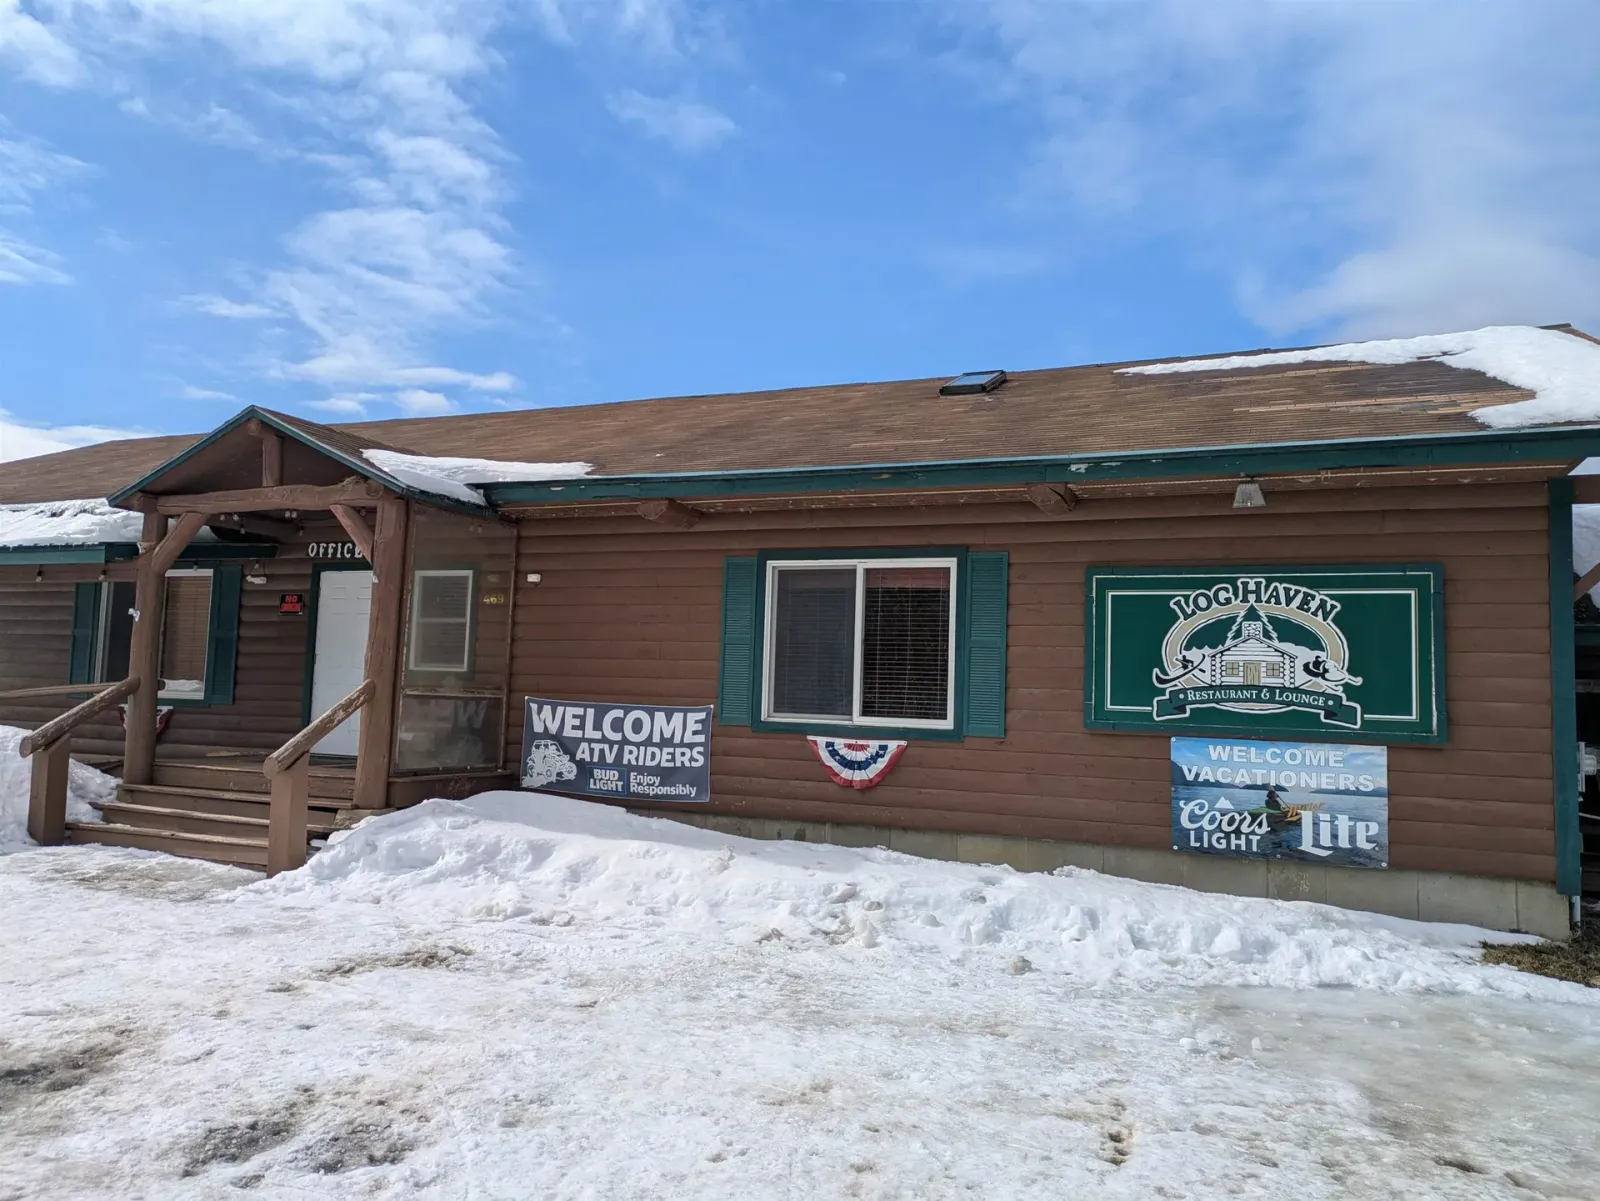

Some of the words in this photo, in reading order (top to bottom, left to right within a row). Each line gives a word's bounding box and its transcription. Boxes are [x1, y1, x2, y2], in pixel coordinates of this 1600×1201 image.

[285, 595, 298, 603] NO
[1171, 584, 1233, 622] LOG
[1238, 579, 1340, 623] HAVEN
[1187, 689, 1258, 701] RESTAURANT
[1261, 688, 1270, 699] &
[1275, 689, 1326, 706] LOUNGE
[529, 702, 707, 744] WELCOME
[575, 742, 619, 763] ATV
[622, 745, 705, 768] RIDERS
[1208, 744, 1345, 768] WELCOME
[589, 780, 624, 792] LIGHT
[593, 768, 619, 781] BUD
[629, 772, 661, 787] Enjoy
[1181, 765, 1375, 792] VACATIONERS
[629, 784, 697, 798] Responsibly
[1179, 799, 1271, 835] Coors
[1189, 830, 1261, 852] LIGHT
[1297, 810, 1380, 857] Lite
